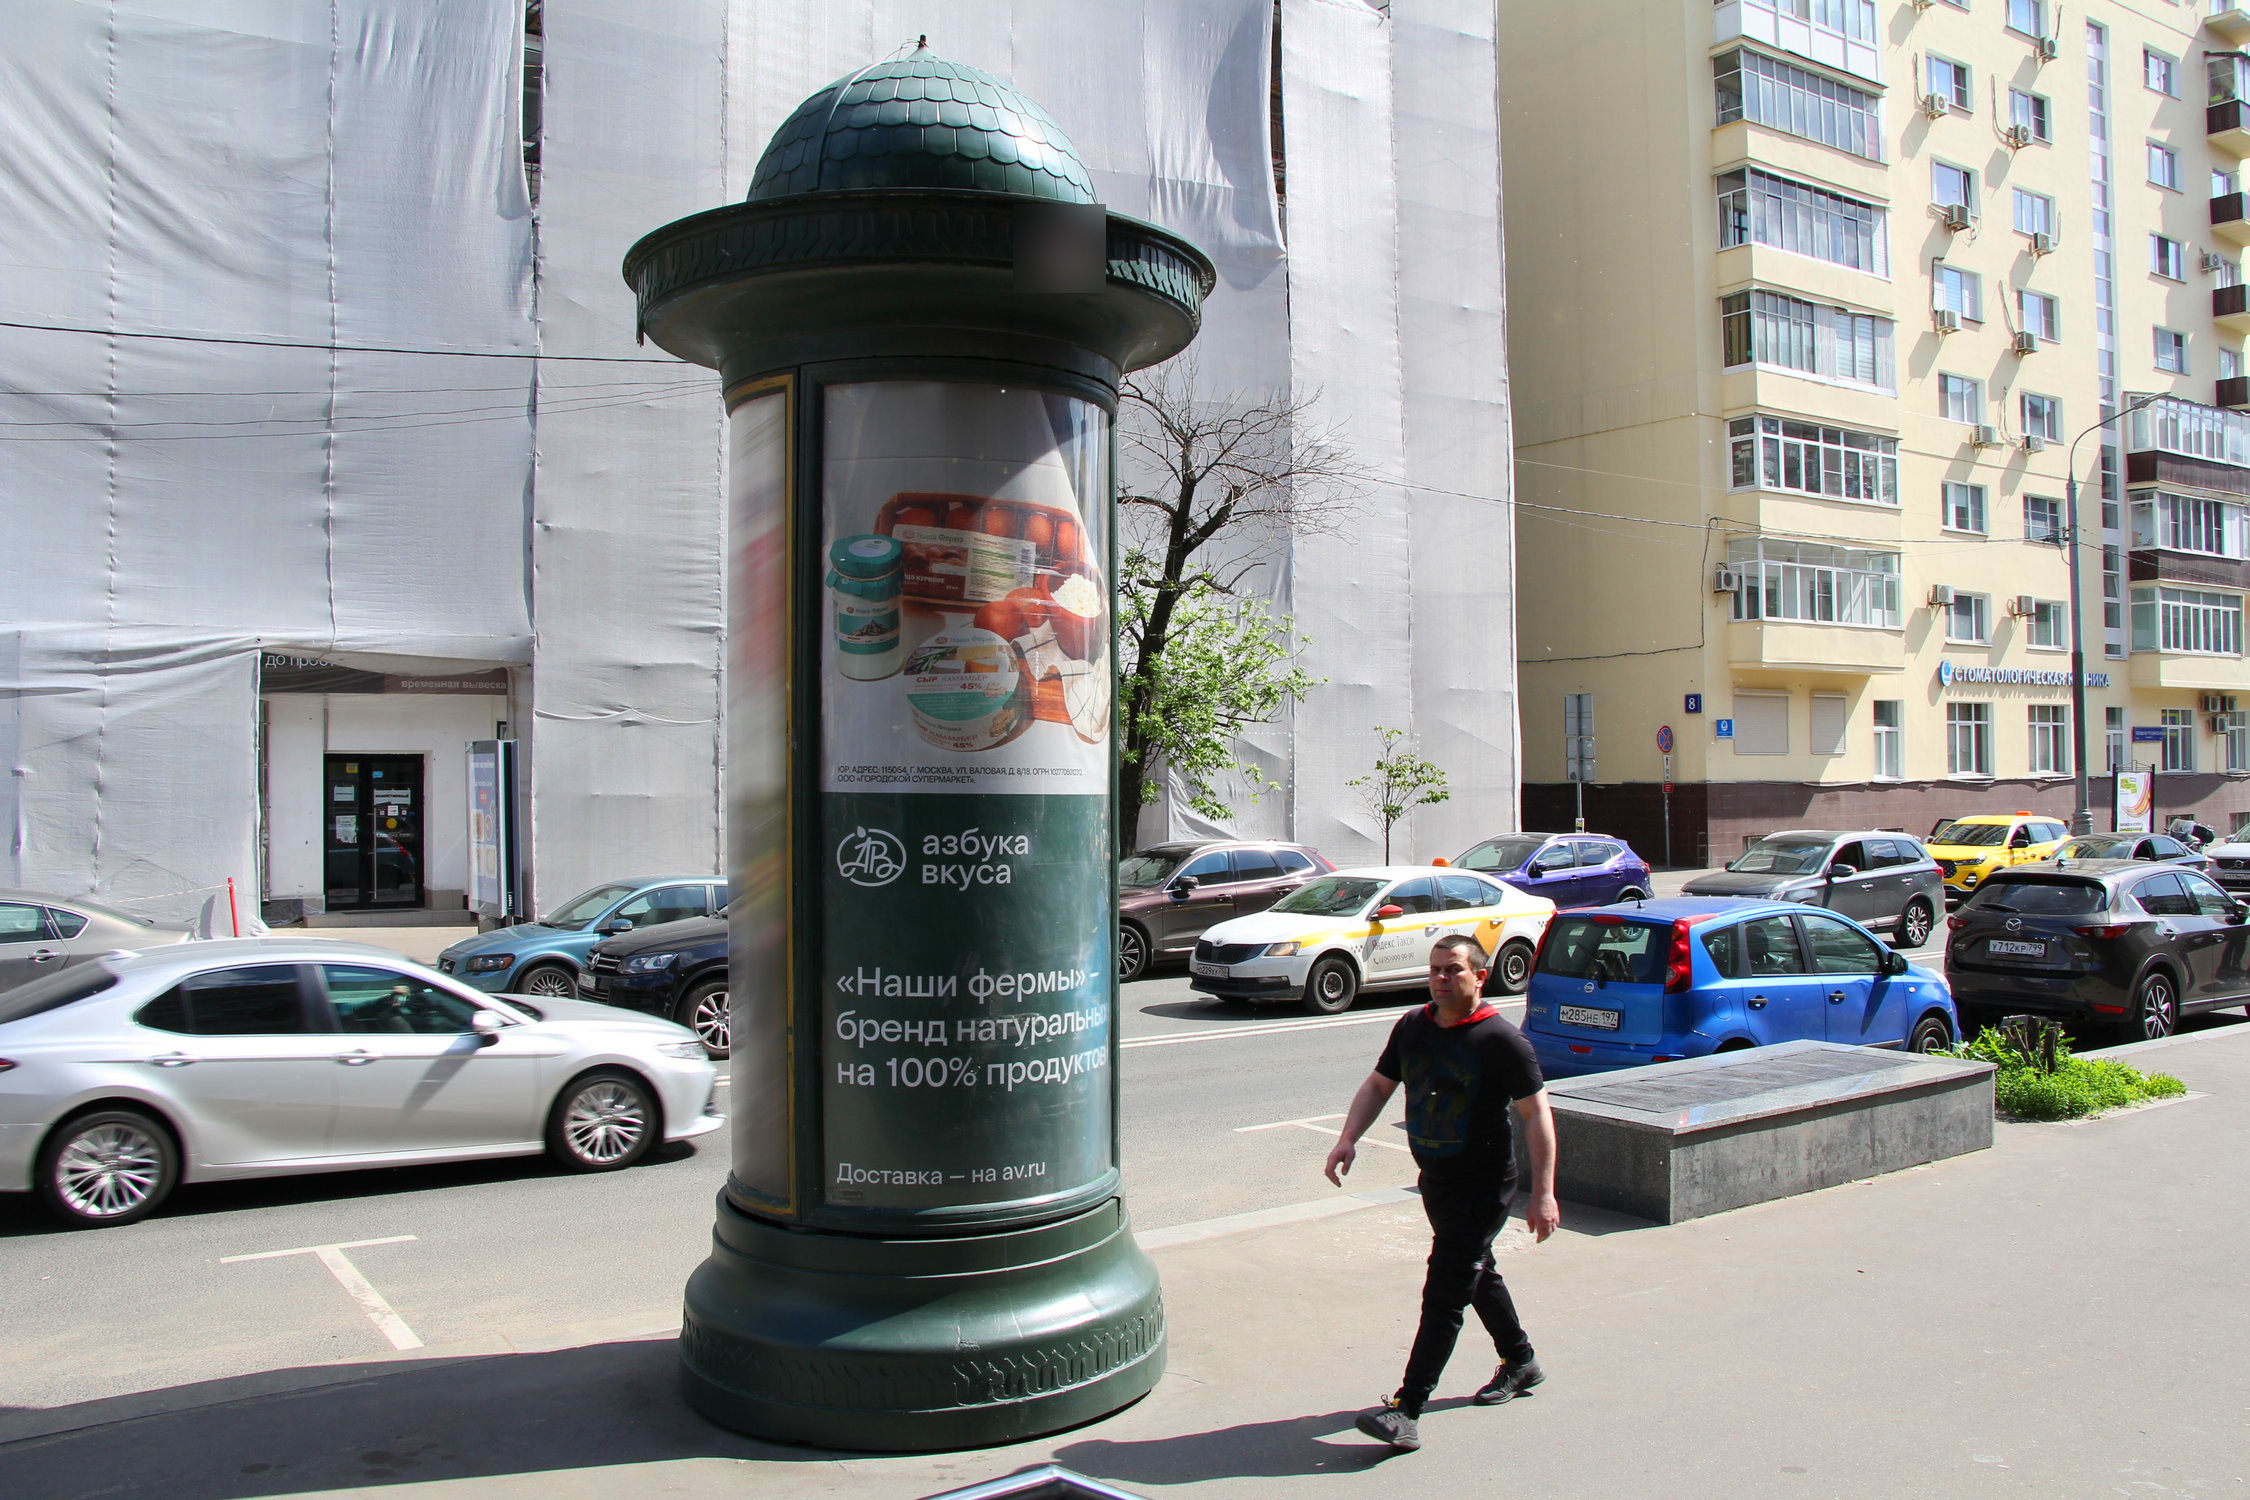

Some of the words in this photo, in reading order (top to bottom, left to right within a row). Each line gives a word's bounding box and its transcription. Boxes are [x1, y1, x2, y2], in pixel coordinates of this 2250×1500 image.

[265, 655, 286, 669] до
[401, 679, 459, 690] временная
[462, 680, 508, 690] вывеска
[1954, 666, 2066, 687] СТОМАТОЛОГИЧЕСКАЯ
[2065, 672, 2110, 688] КНИКА
[1688, 697, 1696, 711] 8
[838, 774, 855, 782] ООО
[857, 774, 911, 783] «ГОРОДСКОЙ
[852, 766, 880, 774] АДРЕС:
[1033, 768, 1049, 776] ОГРН
[922, 827, 1029, 864] азбука
[922, 863, 1011, 891] вкуса
[836, 966, 957, 997] «Наши
[968, 967, 1086, 1005] фермы»
[1601, 1011, 1616, 1022] 197
[836, 1010, 947, 1049] бренд
[837, 1060, 875, 1086] на
[886, 1056, 977, 1087] 100%
[987, 1045, 1107, 1092] продуктов
[836, 1162, 943, 1185] Доставка
[971, 1168, 996, 1183] на
[1002, 1161, 1046, 1181] av.ru
